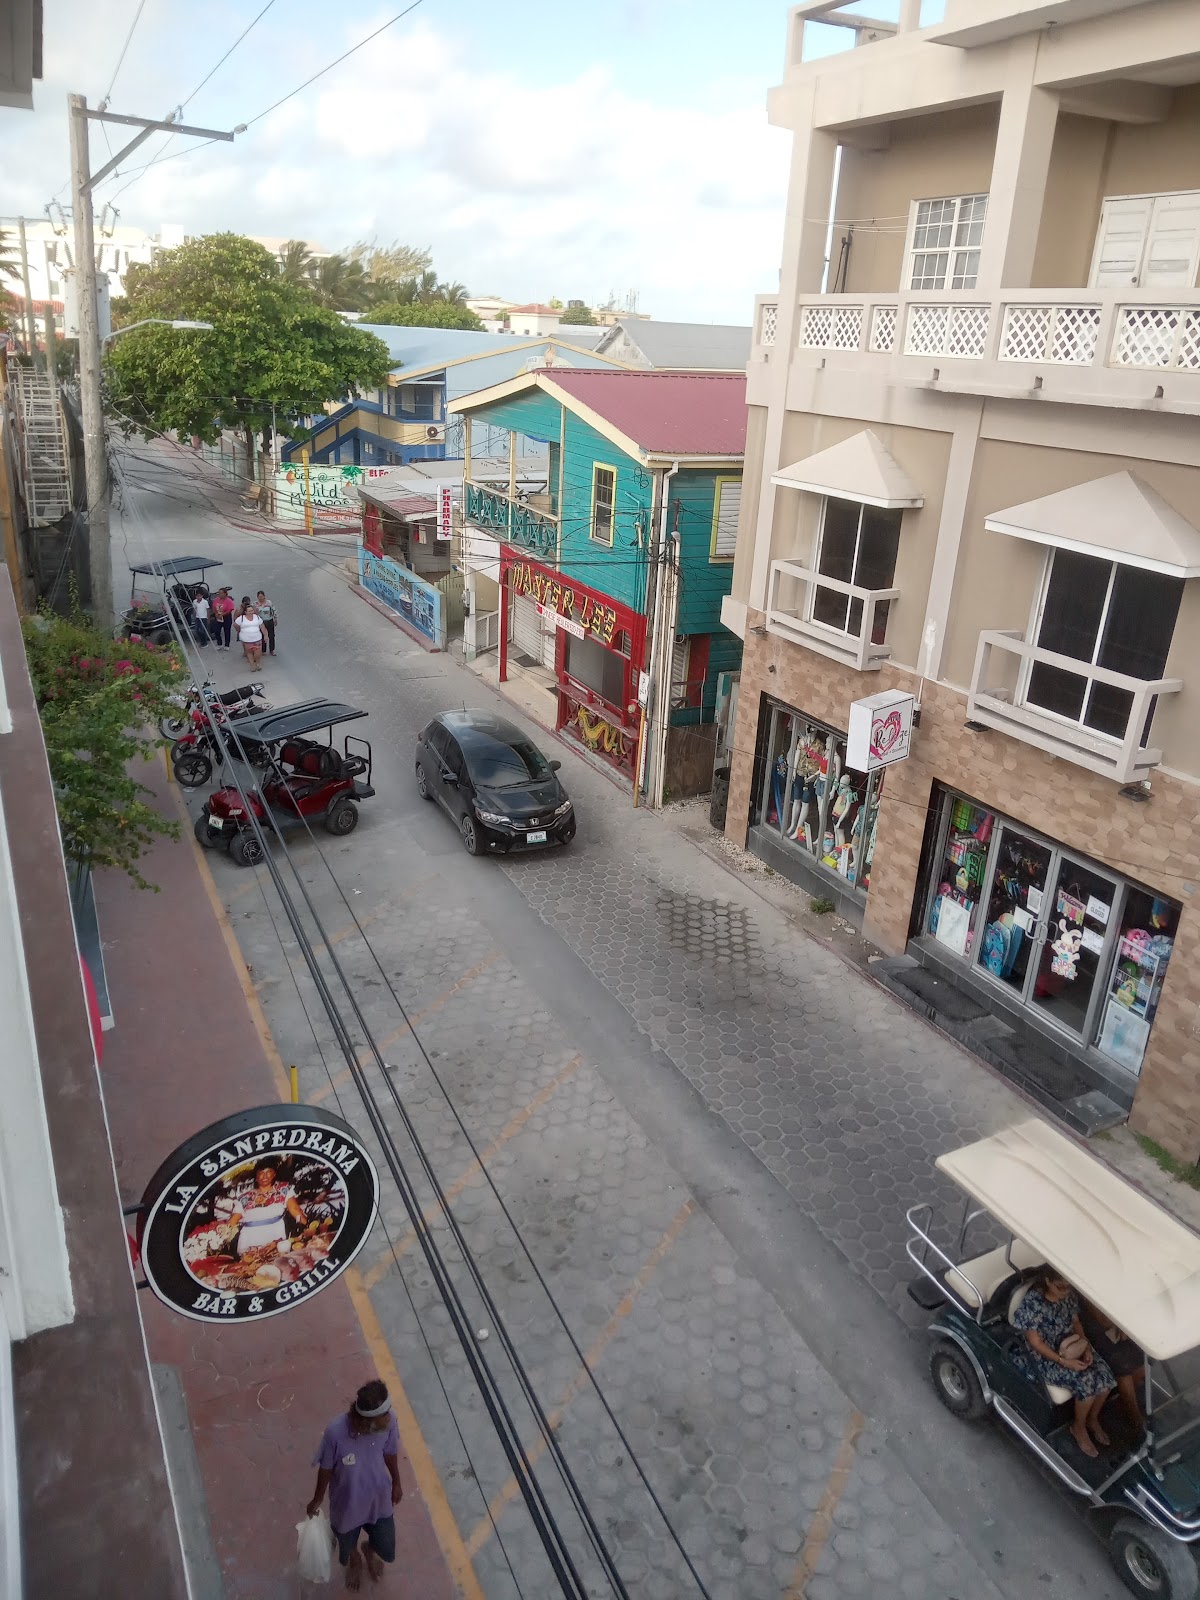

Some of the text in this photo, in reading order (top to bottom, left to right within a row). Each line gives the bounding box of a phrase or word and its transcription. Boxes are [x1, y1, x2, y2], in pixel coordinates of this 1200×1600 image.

[300, 481, 338, 499] Wild
[442, 488, 451, 537] PHARMACY
[513, 562, 616, 643] MASTER LEE
[165, 1129, 361, 1215] LA SANPEDRANA
[192, 1257, 341, 1314] BAR & GRILL
